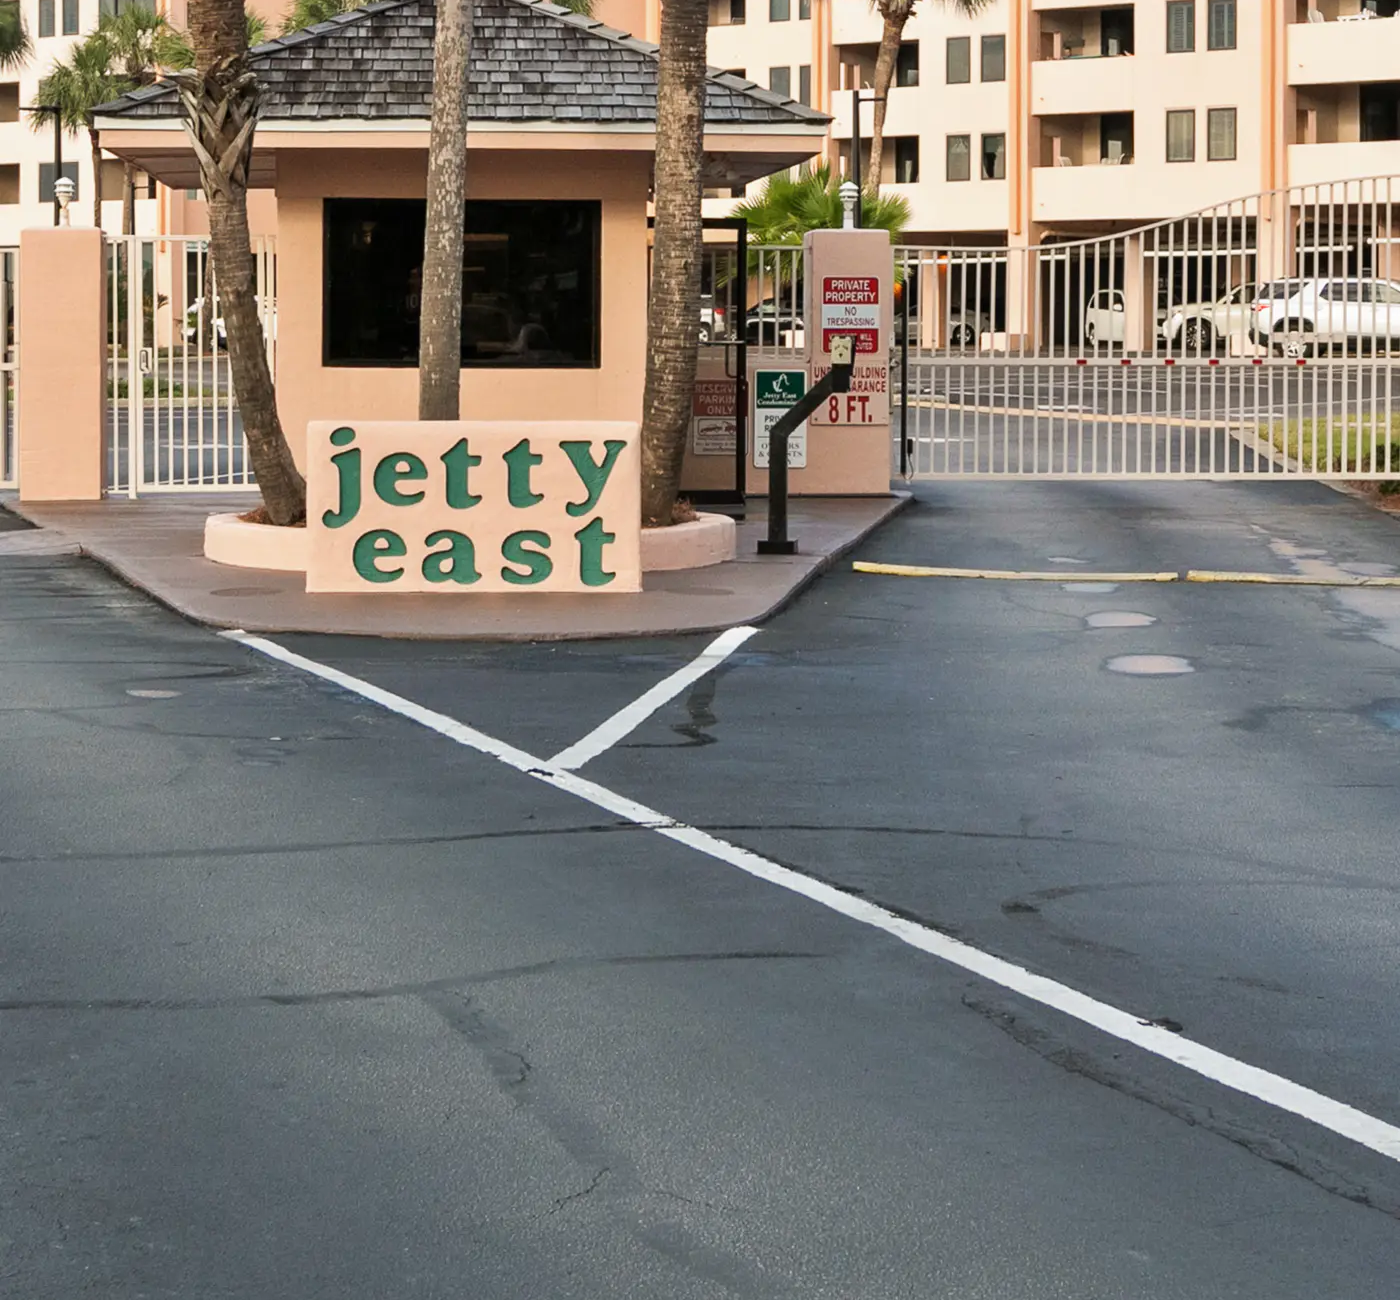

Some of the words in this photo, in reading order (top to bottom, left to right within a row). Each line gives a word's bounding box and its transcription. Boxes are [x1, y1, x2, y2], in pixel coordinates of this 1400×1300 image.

[831, 280, 870, 290] PRIVATE
[825, 292, 876, 302] PROPERTY
[844, 306, 857, 316] NO
[827, 317, 875, 326] TRESPASSING
[852, 367, 886, 378] UILDING
[695, 384, 737, 393] RESERV
[851, 381, 886, 392] ARANCE
[699, 394, 736, 404] PARKIN
[707, 405, 734, 415] ONLY
[829, 395, 839, 423] 8
[847, 396, 872, 422] FT.
[321, 426, 627, 528] jetty
[352, 516, 616, 586] east
